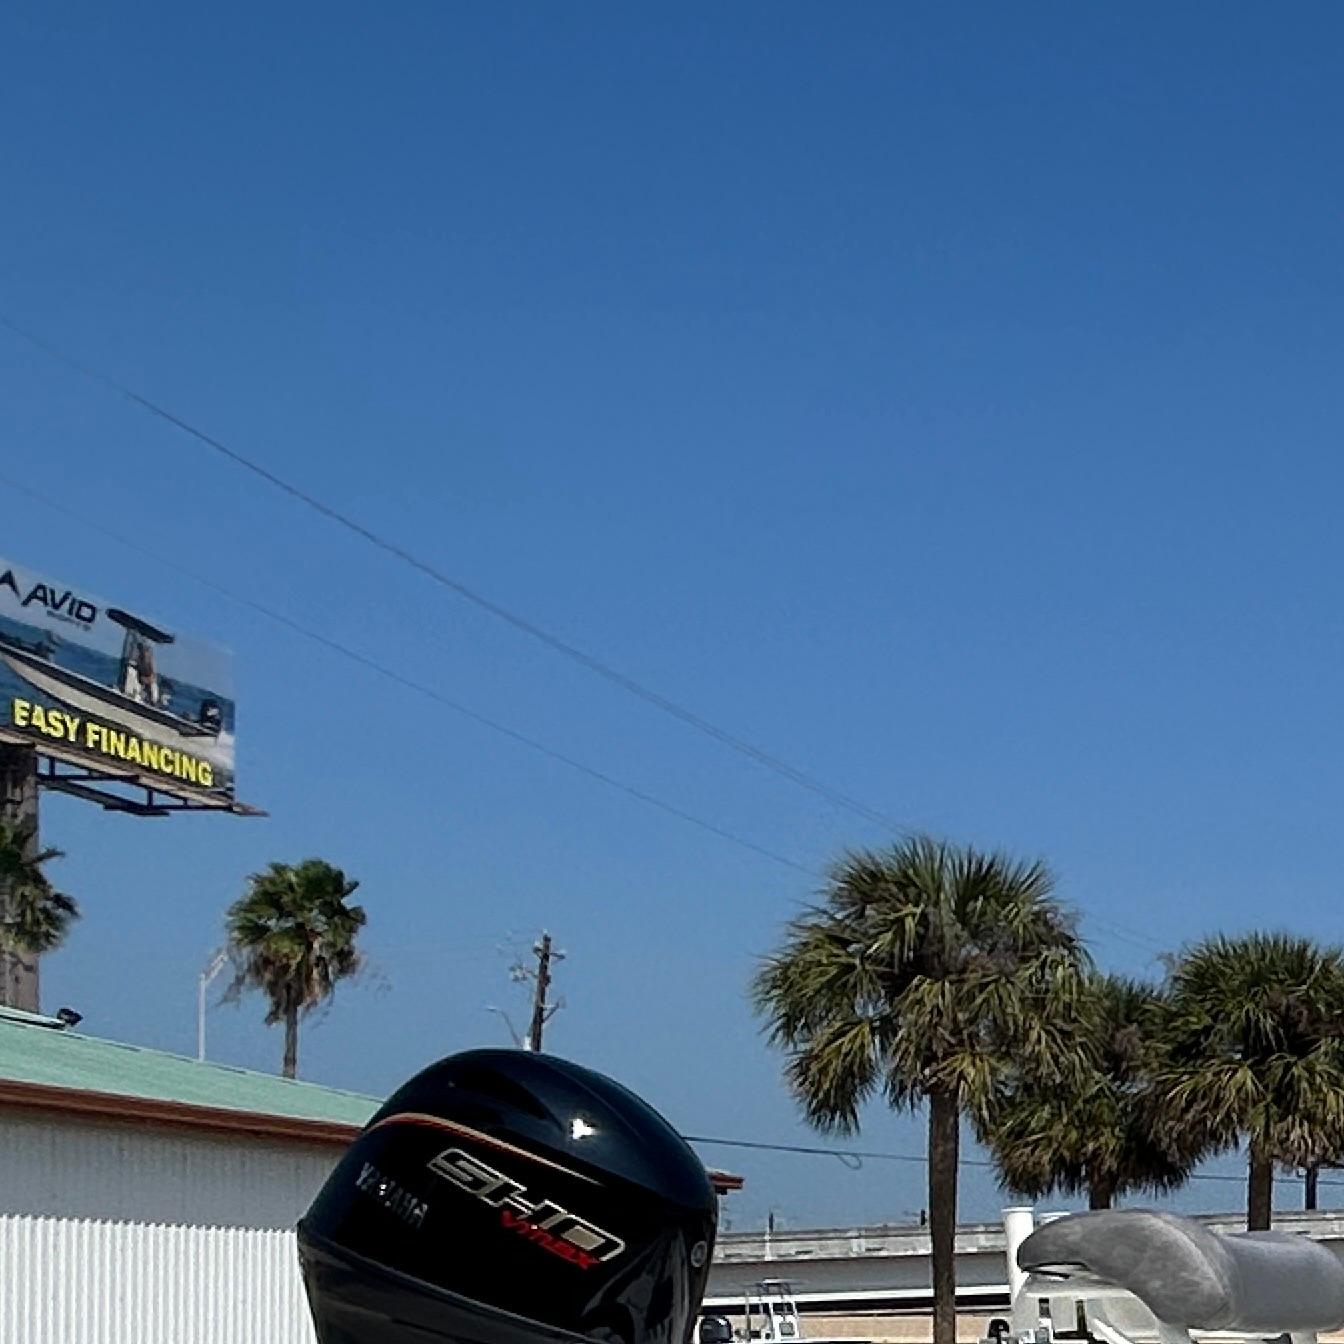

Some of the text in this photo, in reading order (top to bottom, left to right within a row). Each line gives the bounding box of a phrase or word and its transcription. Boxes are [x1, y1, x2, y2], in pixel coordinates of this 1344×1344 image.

[21, 583, 97, 623] AVID
[11, 698, 214, 787] EASY FINANCING
[427, 1147, 626, 1262] SHO
